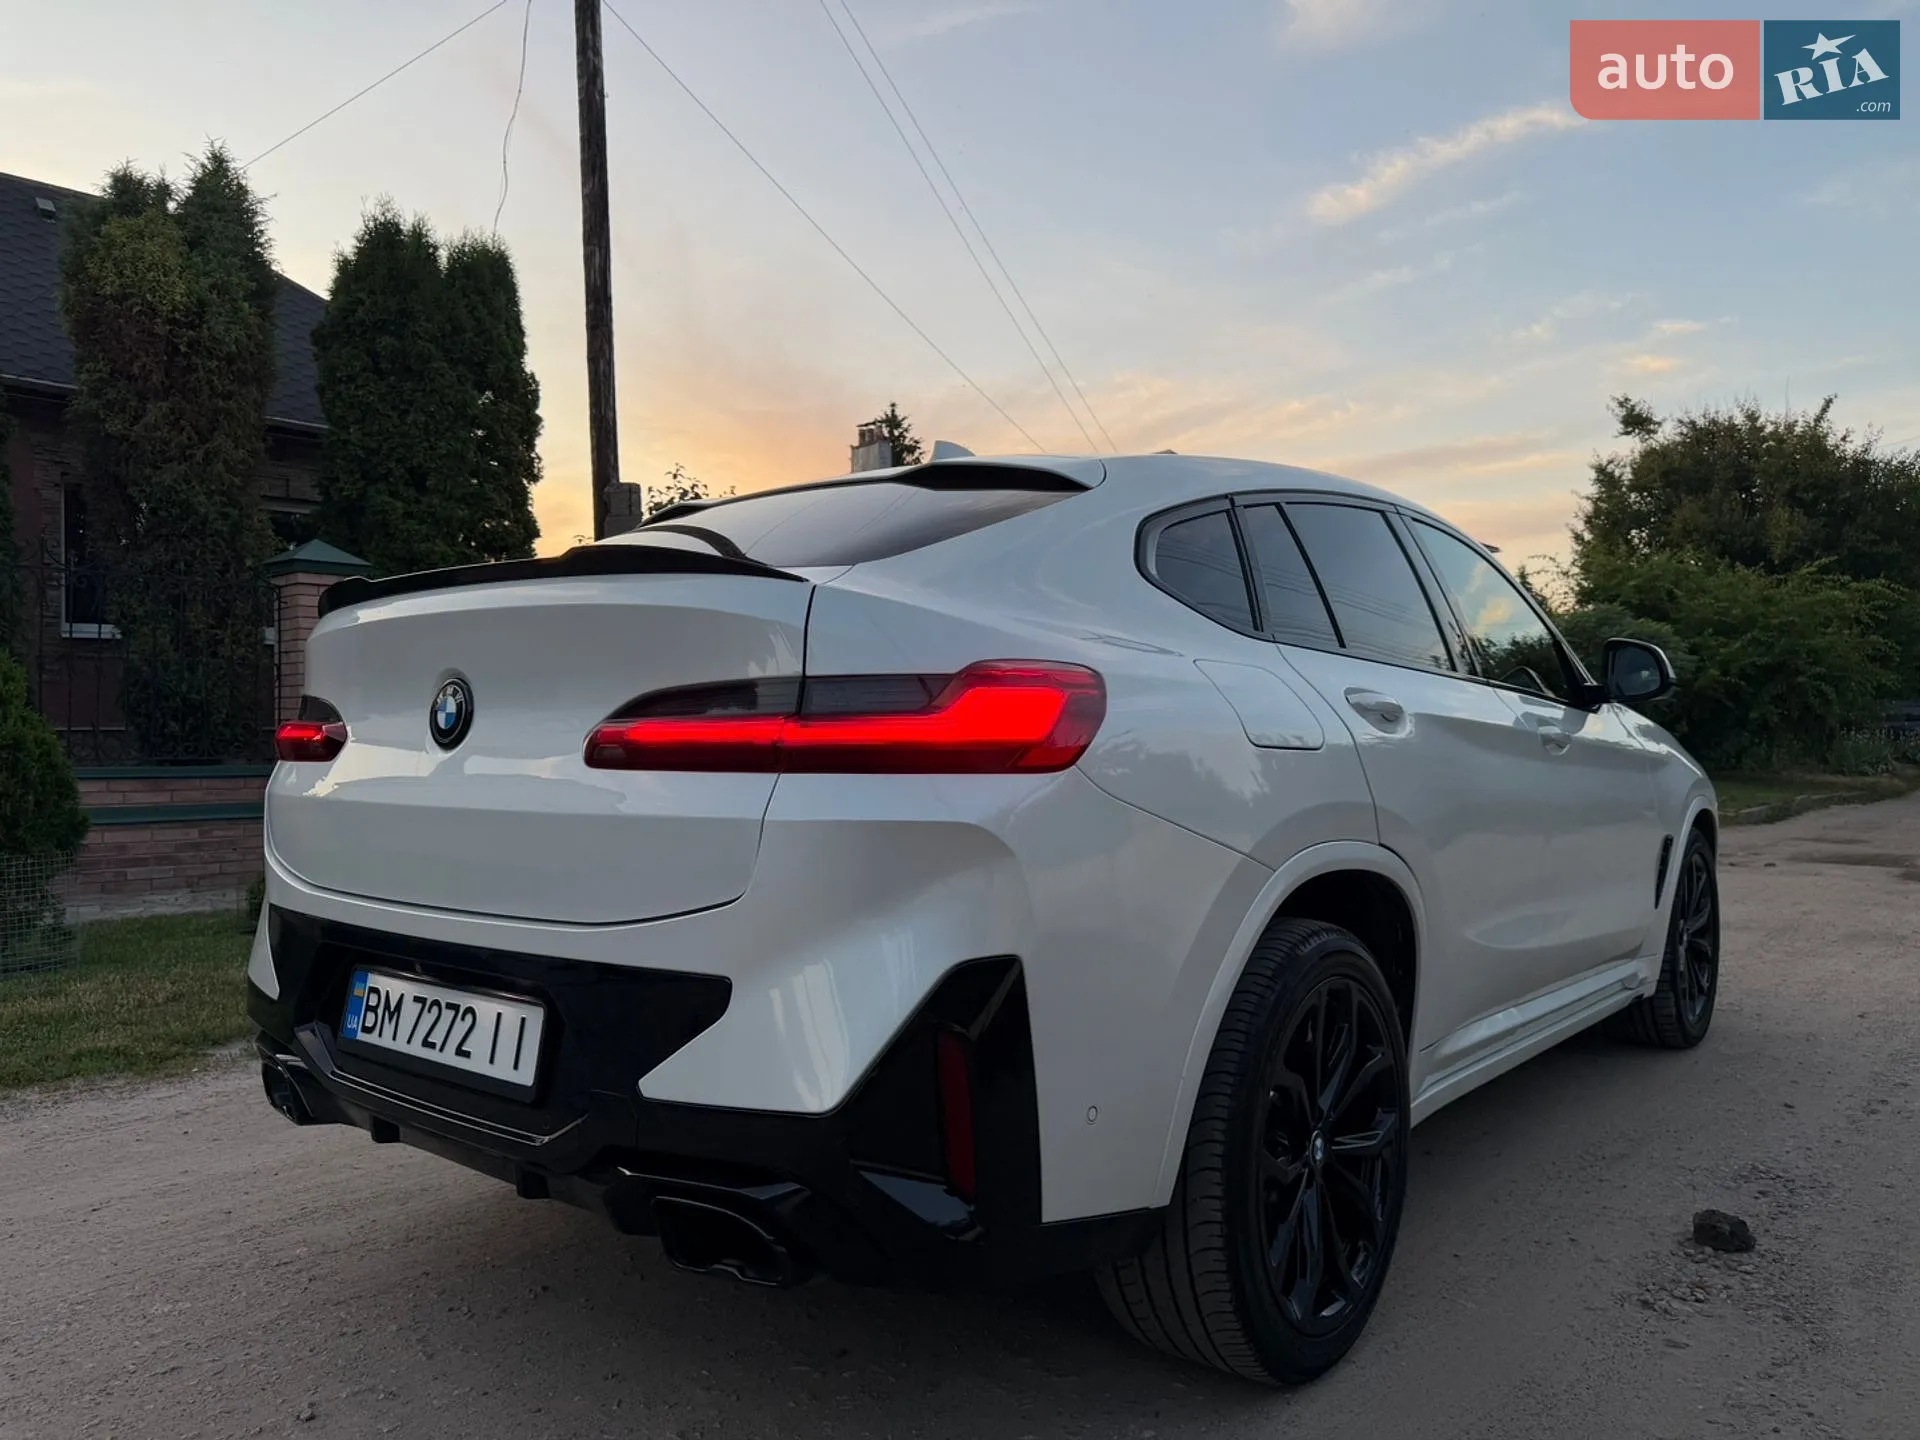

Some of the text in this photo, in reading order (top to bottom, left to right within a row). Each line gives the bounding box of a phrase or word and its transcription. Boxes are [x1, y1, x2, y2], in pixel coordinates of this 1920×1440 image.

[346, 1013, 358, 1031] UA
[361, 986, 405, 1042] BM
[406, 995, 478, 1060] 7272
